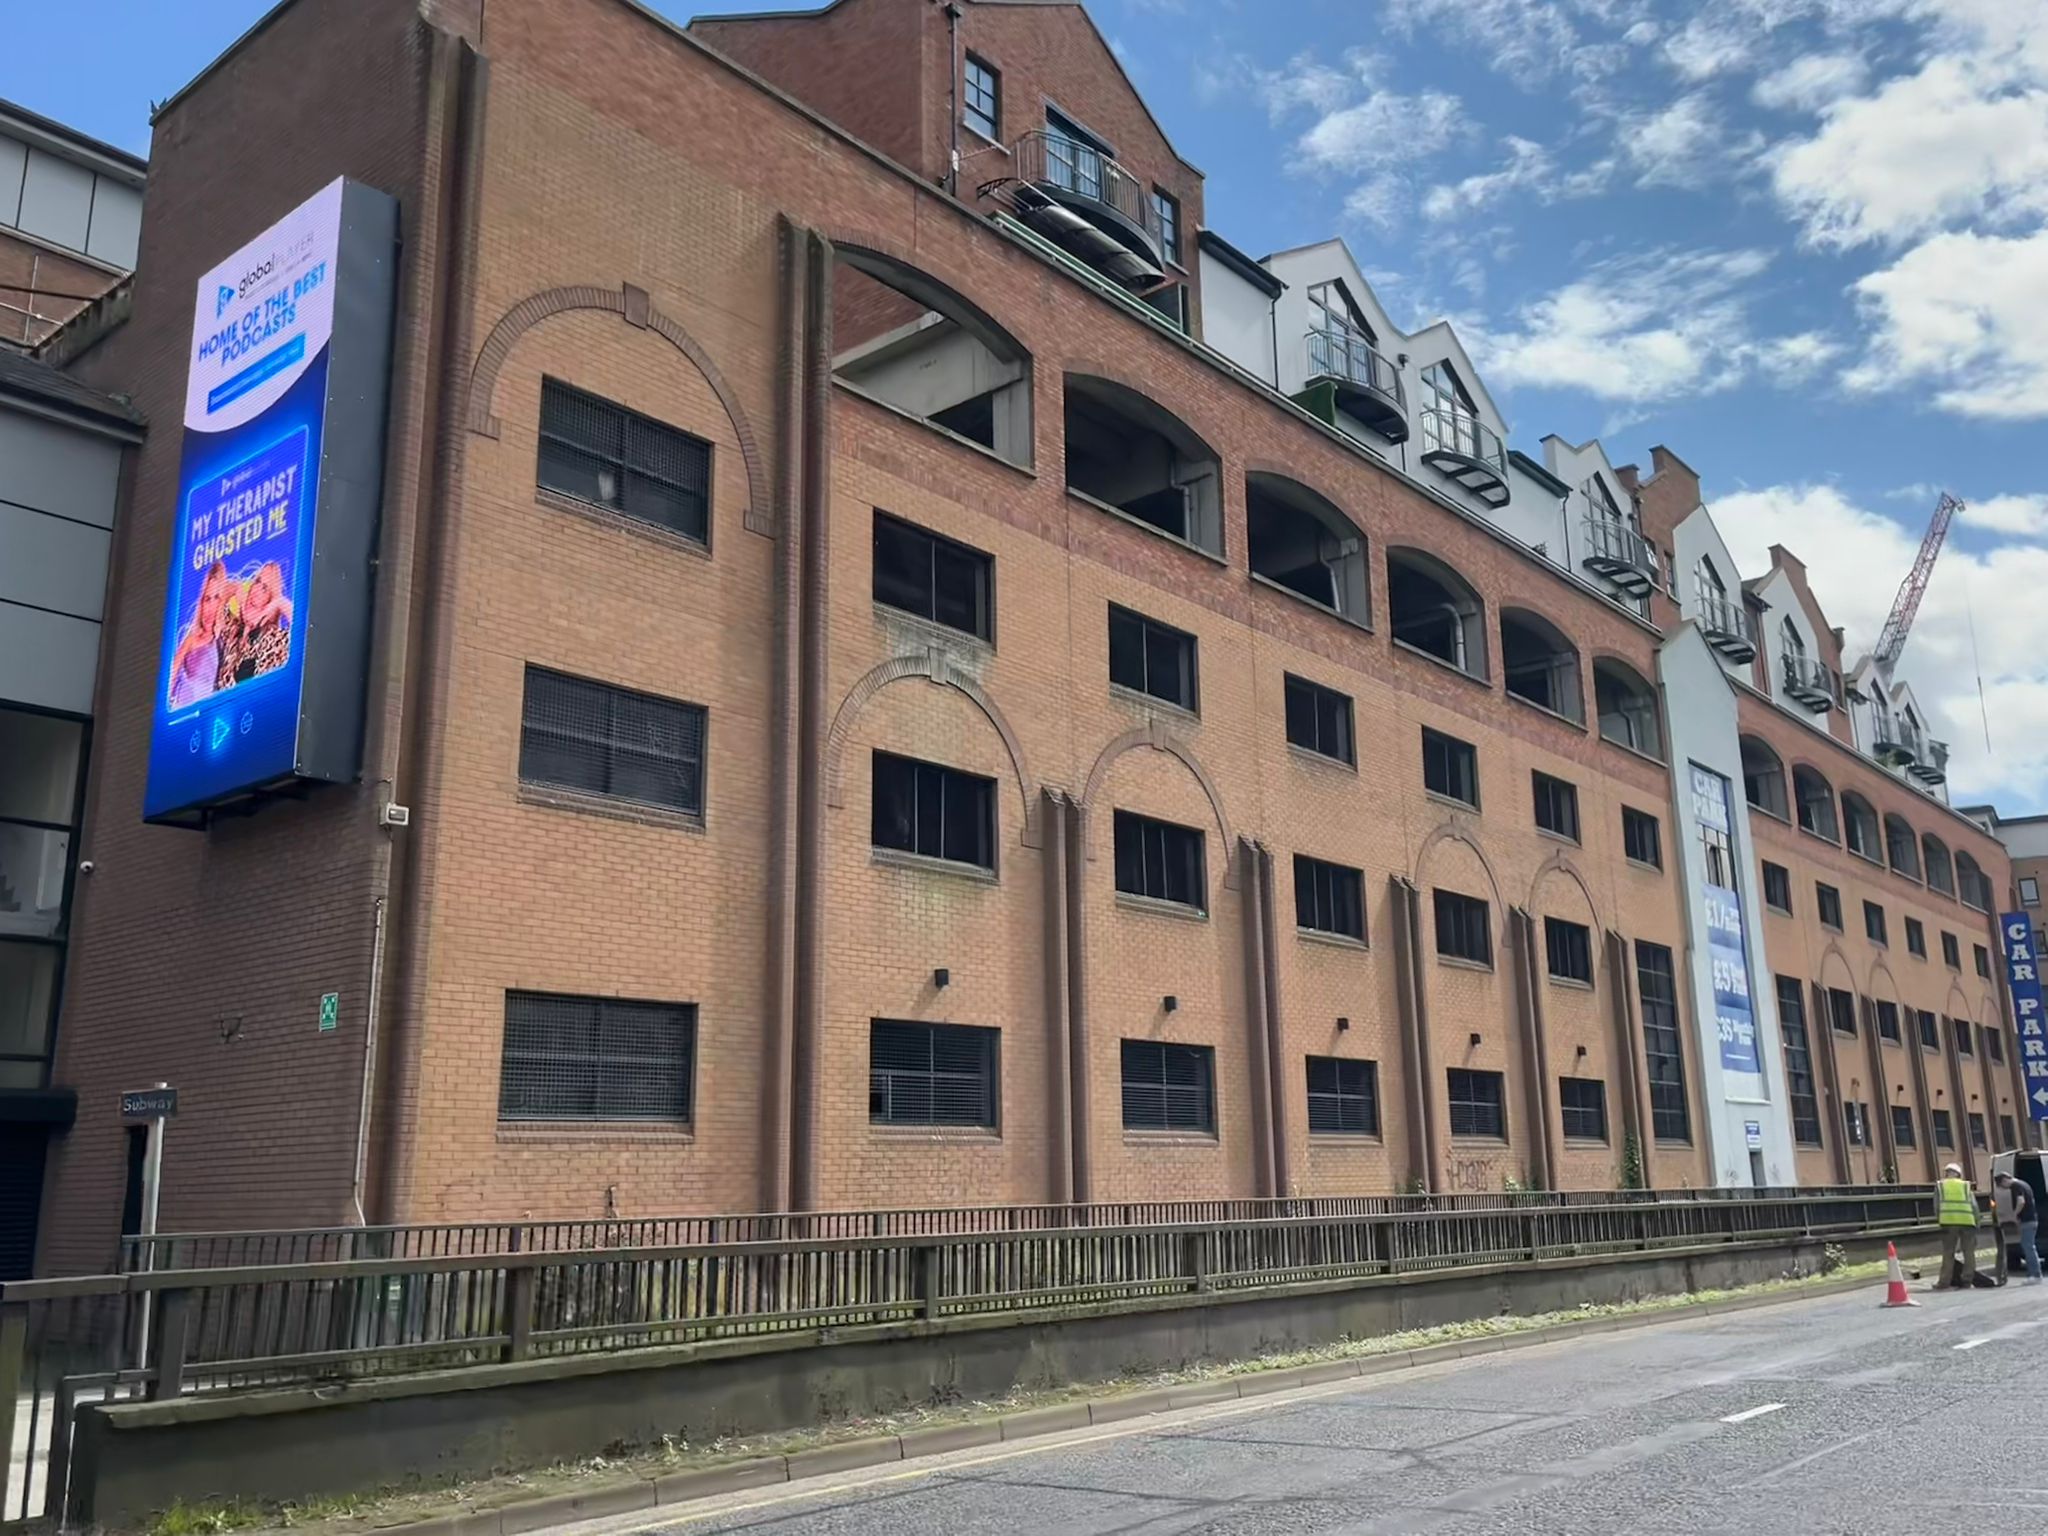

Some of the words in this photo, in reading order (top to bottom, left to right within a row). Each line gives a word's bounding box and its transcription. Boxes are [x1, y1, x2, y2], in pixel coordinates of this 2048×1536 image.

[239, 252, 276, 299] global
[198, 320, 239, 361] HOME
[242, 304, 261, 333] OF
[264, 286, 290, 320] THE
[293, 261, 328, 300] BEST
[221, 302, 297, 366] PODCASTS
[191, 511, 214, 543] MY
[217, 464, 298, 531] THERAPIST
[193, 513, 263, 571] GHOSTED
[267, 500, 289, 532] ME
[2008, 923, 2035, 981] CAR
[2018, 998, 2048, 1077] PARK
[123, 1096, 174, 1111] Subway
